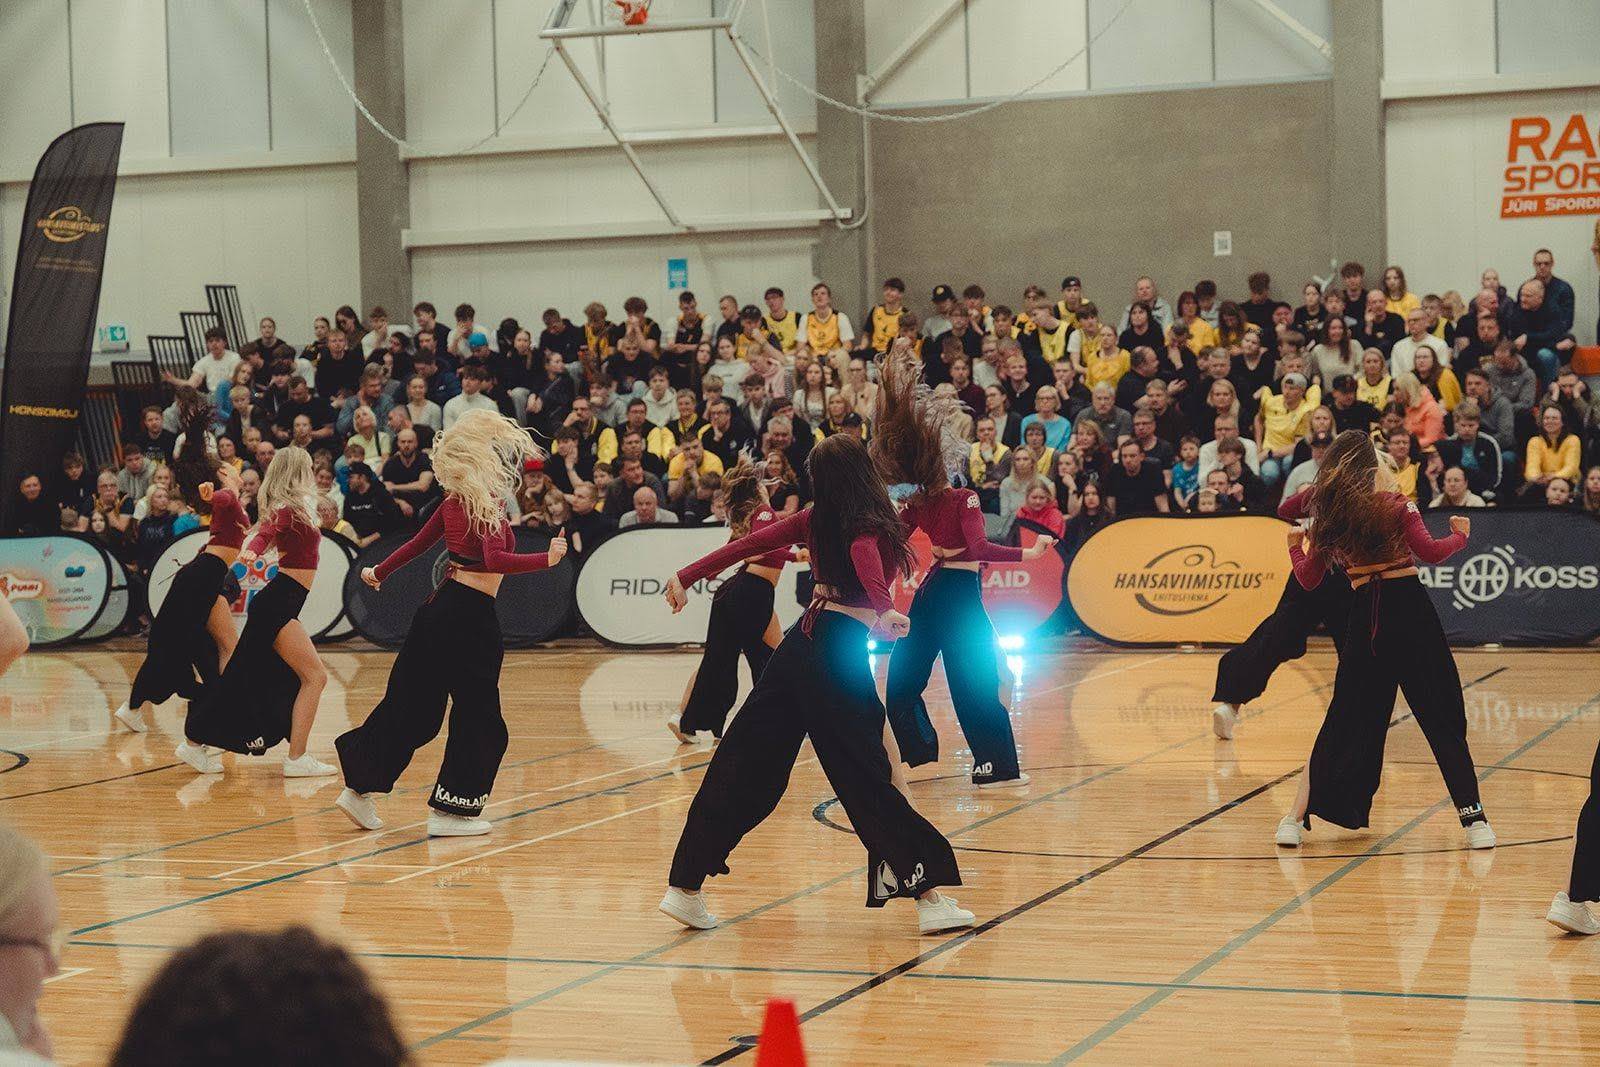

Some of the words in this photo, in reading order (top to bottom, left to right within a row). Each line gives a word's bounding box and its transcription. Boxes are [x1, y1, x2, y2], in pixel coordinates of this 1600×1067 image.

[1508, 114, 1600, 162] RA
[610, 578, 725, 596] RIDNG
[1114, 572, 1264, 590] HANSAVIIMISTLUS
[1514, 565, 1599, 590] KOSS
